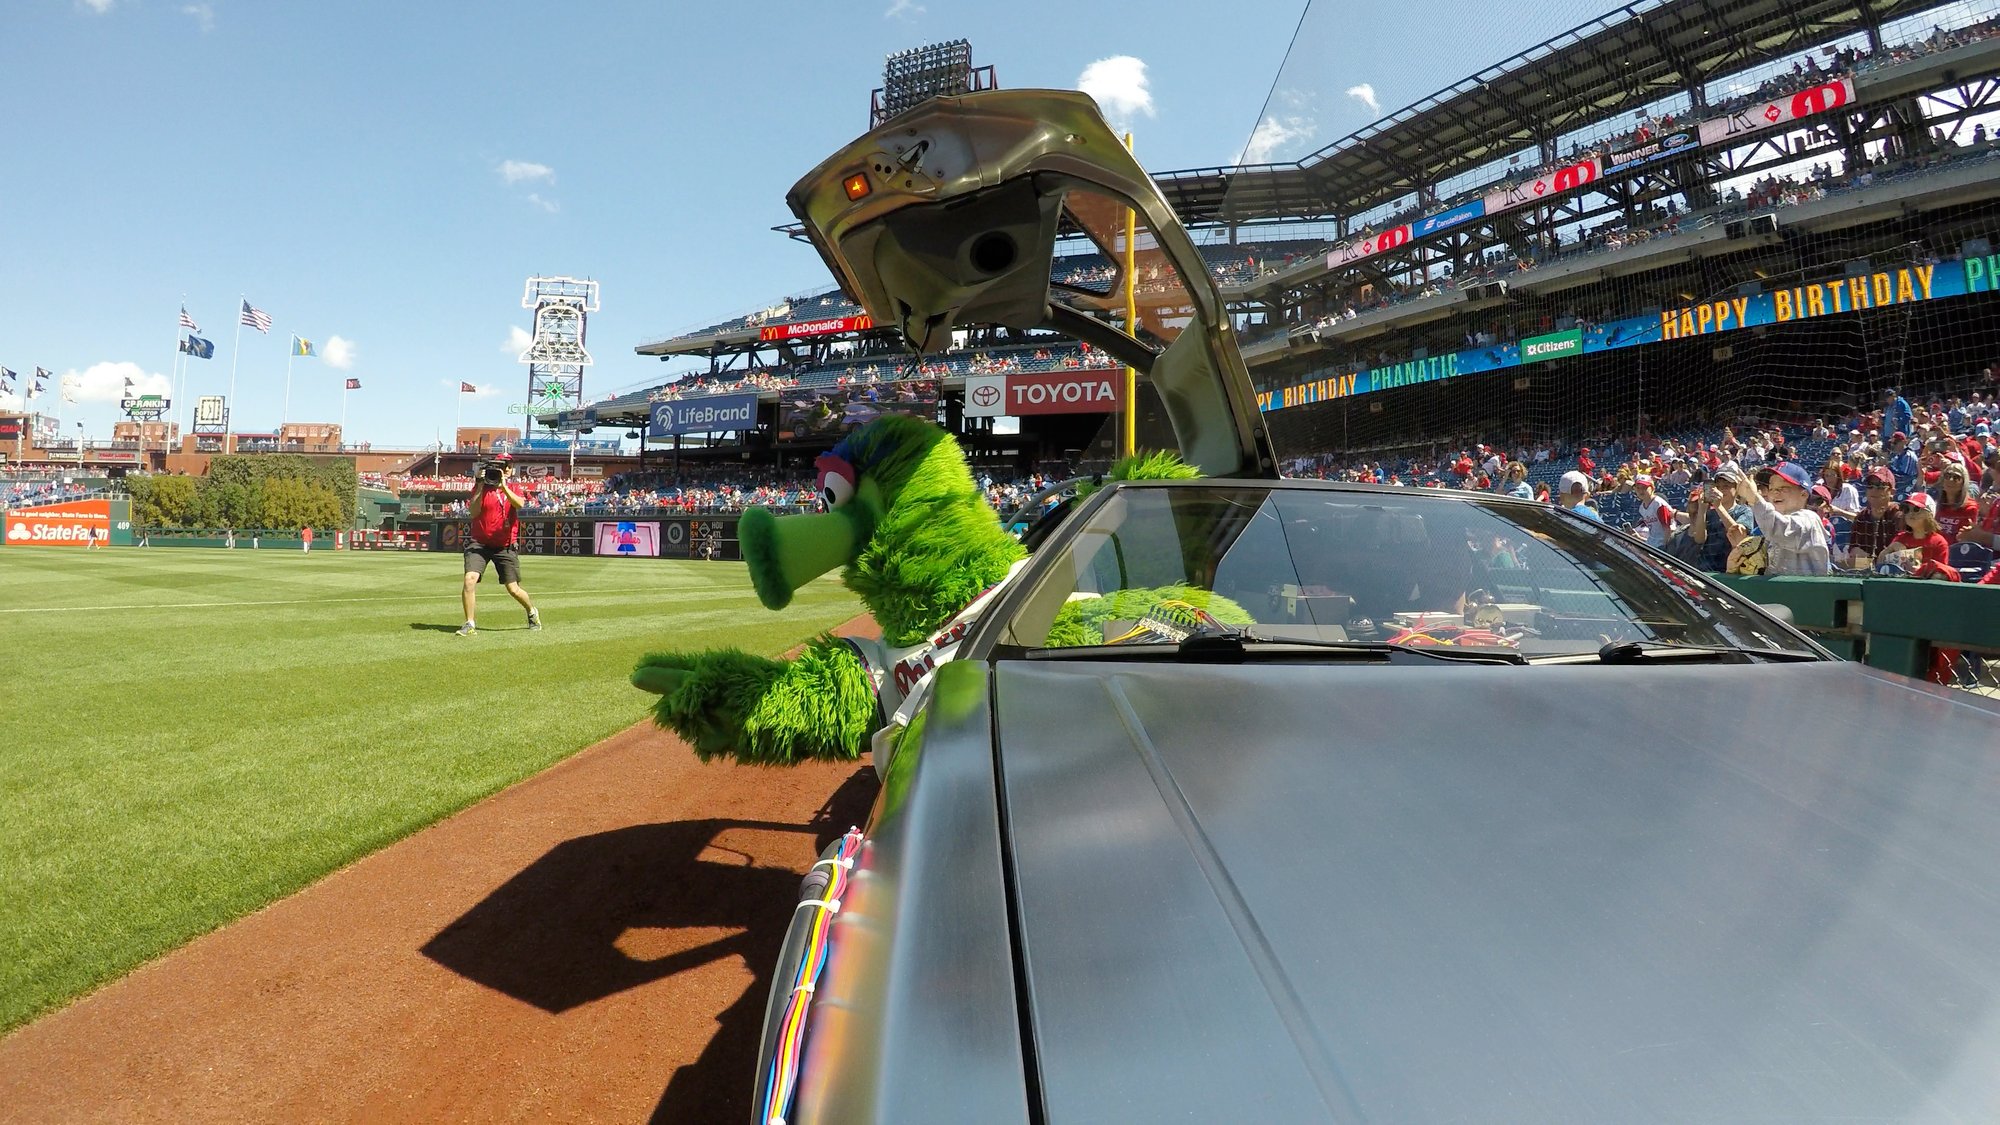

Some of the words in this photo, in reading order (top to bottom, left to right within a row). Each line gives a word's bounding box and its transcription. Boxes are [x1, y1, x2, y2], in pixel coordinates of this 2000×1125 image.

[1610, 143, 1660, 165] WINNER
[1661, 296, 1748, 341] HAPPY
[1774, 264, 1934, 323] BIRTHDAY
[787, 319, 844, 335] McDonald's
[1537, 339, 1575, 354] Citizens
[1284, 373, 1358, 408] BIRTHDAY
[1371, 352, 1458, 392] PHANATIC
[1012, 381, 1116, 404] TOYOTA
[678, 403, 750, 425] LifeBrand
[117, 521, 130, 530] 409
[711, 521, 723, 530] HOU
[610, 529, 641, 545] Phillies
[713, 530, 722, 538] ATL
[713, 550, 721, 558] PIT
